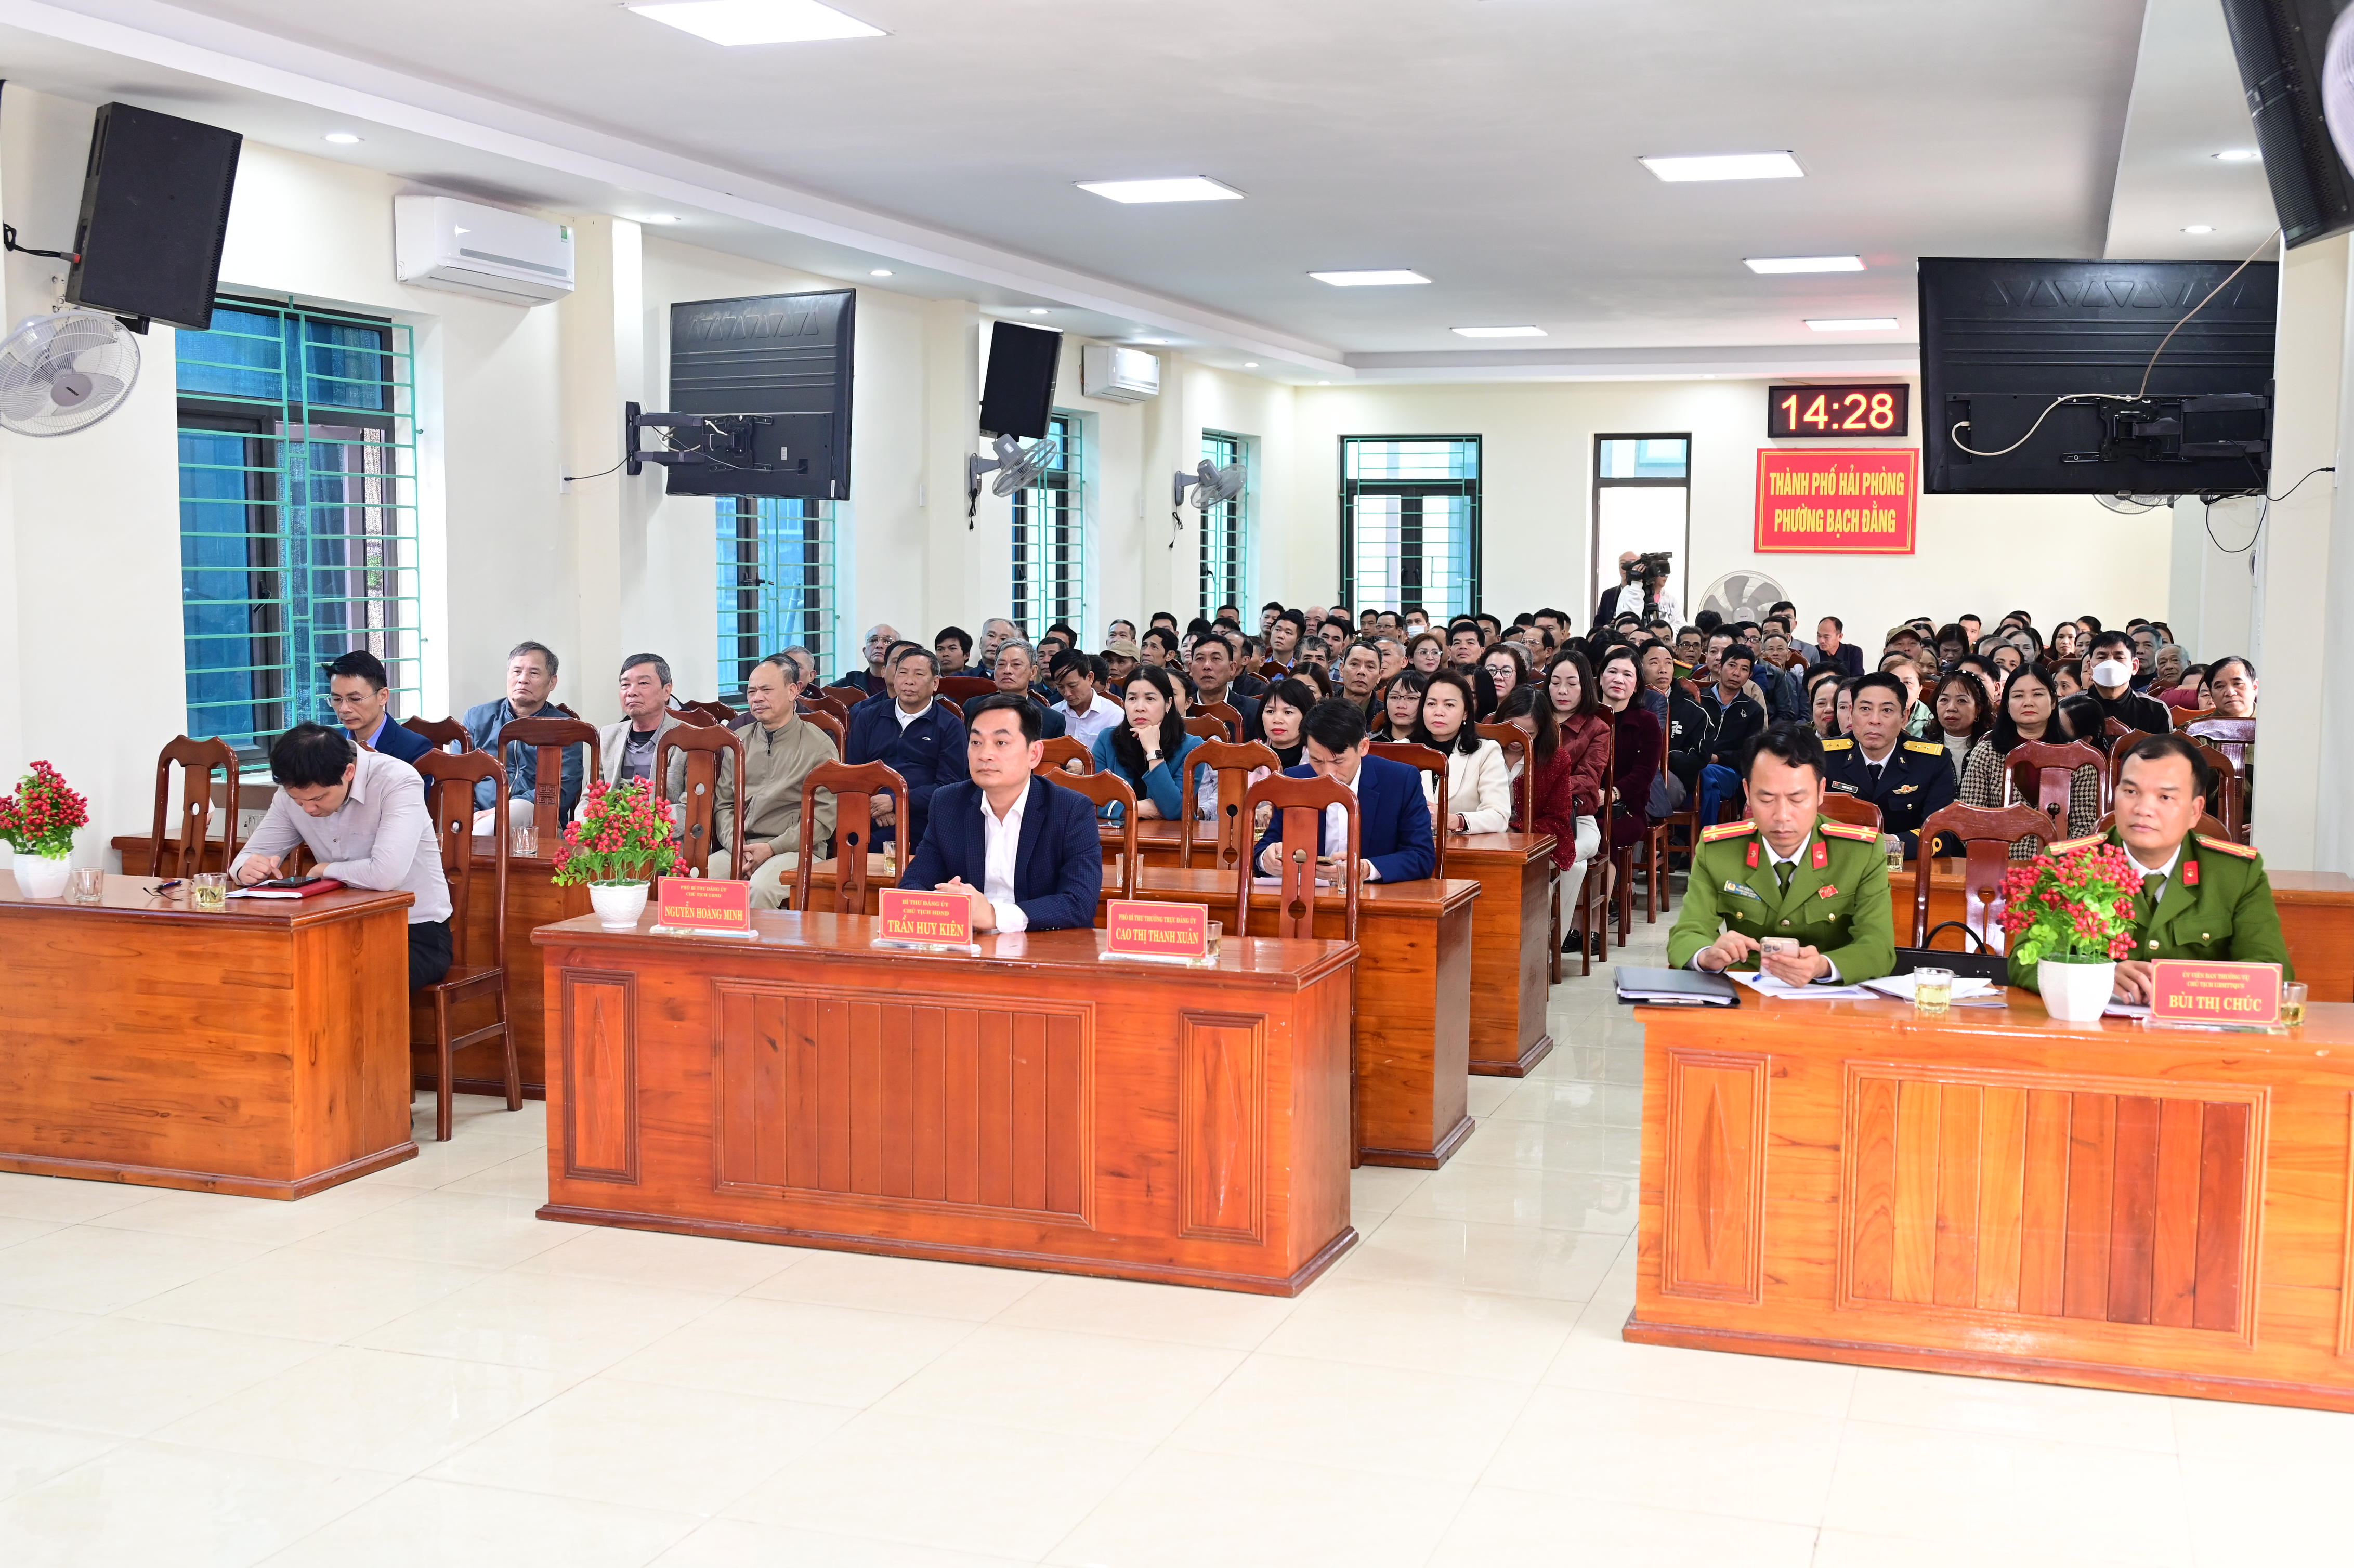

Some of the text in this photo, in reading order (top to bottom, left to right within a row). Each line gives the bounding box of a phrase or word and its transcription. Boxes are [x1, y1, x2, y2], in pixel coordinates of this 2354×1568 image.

[1782, 393, 1894, 430] 14:28
[1770, 464, 1905, 495] THÀNH PHỐ HẢI PHÒNG
[1774, 501, 1896, 538] PHƯỜNG BẠCH ĐẰNG
[665, 901, 742, 921] NGUYỄN HOÀNG MINH
[887, 914, 964, 936] TRẦN HUY KIÊN
[1116, 927, 1199, 944] CAO THỊ THANH XUÂN
[2169, 991, 2262, 1013] BÙI THỊ CHÚC
